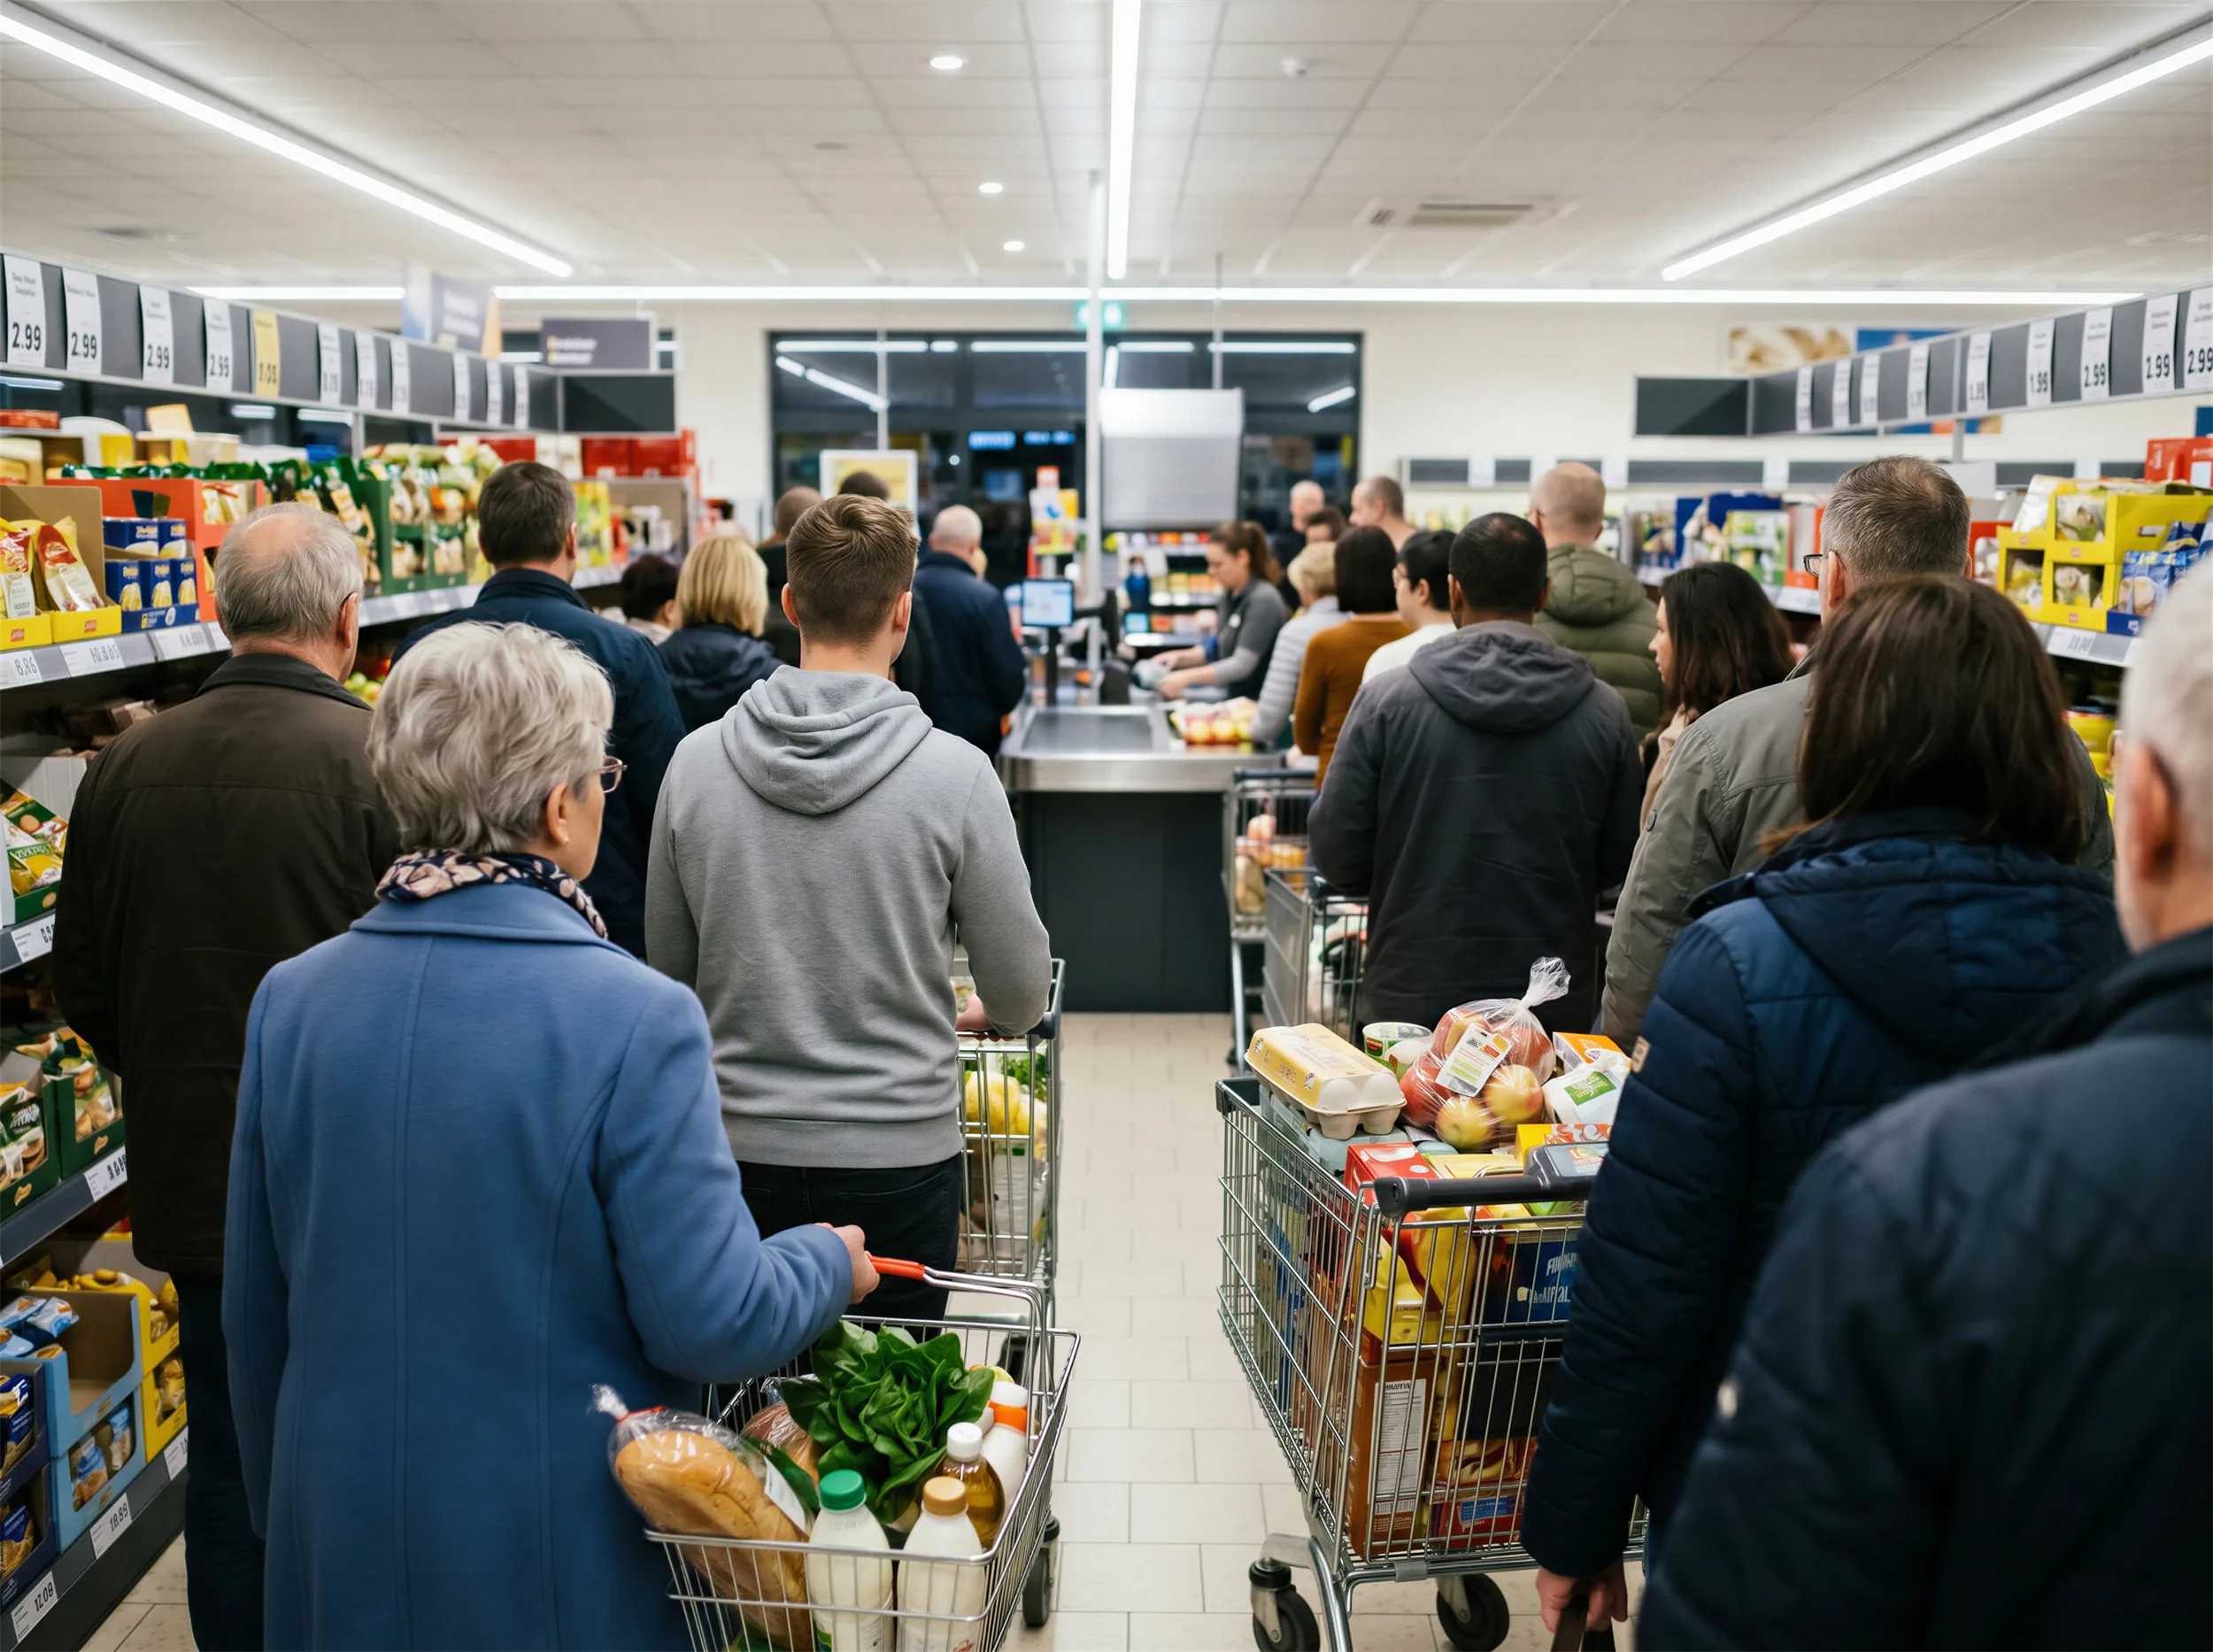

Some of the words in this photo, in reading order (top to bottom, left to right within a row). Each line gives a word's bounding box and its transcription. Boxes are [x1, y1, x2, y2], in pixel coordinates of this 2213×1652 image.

[12, 321, 41, 351] 2.99
[71, 332, 97, 359] 2.99
[147, 344, 170, 369] 2.99
